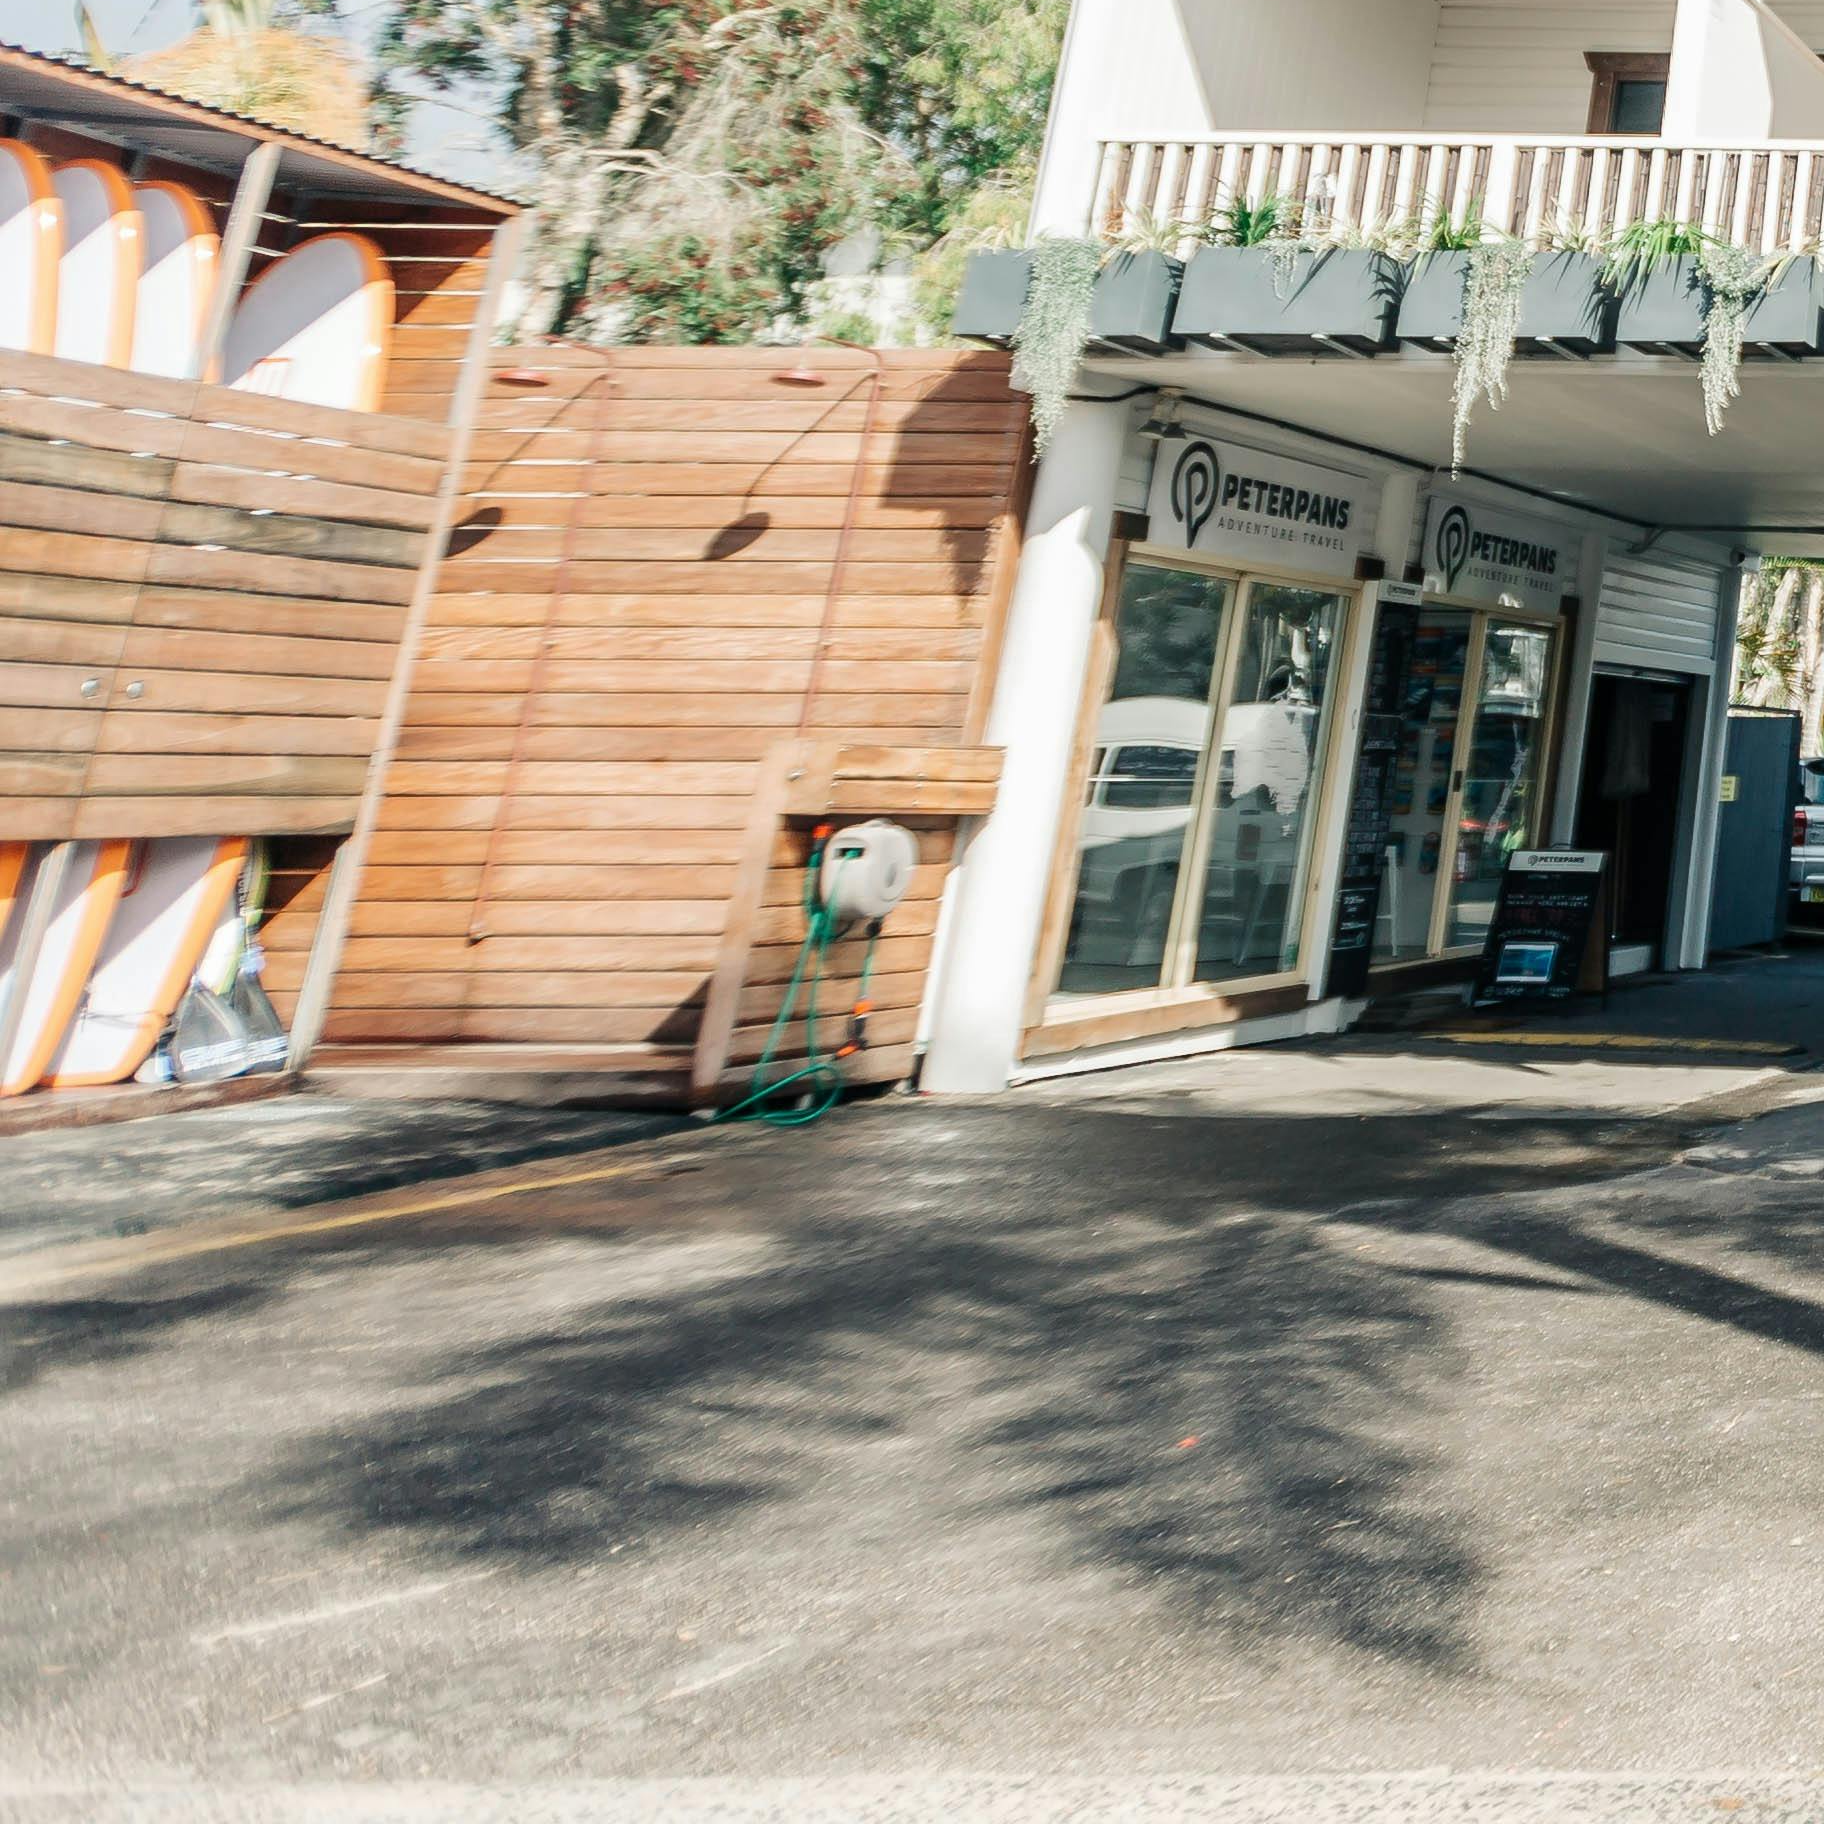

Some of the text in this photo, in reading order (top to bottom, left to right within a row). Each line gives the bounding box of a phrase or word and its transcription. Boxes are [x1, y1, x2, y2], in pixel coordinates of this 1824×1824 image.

[1221, 473, 1350, 530] PETERPANS
[1217, 516, 1344, 551] ADVENTURE TRAVEL
[1470, 531, 1557, 574] PETERPANS
